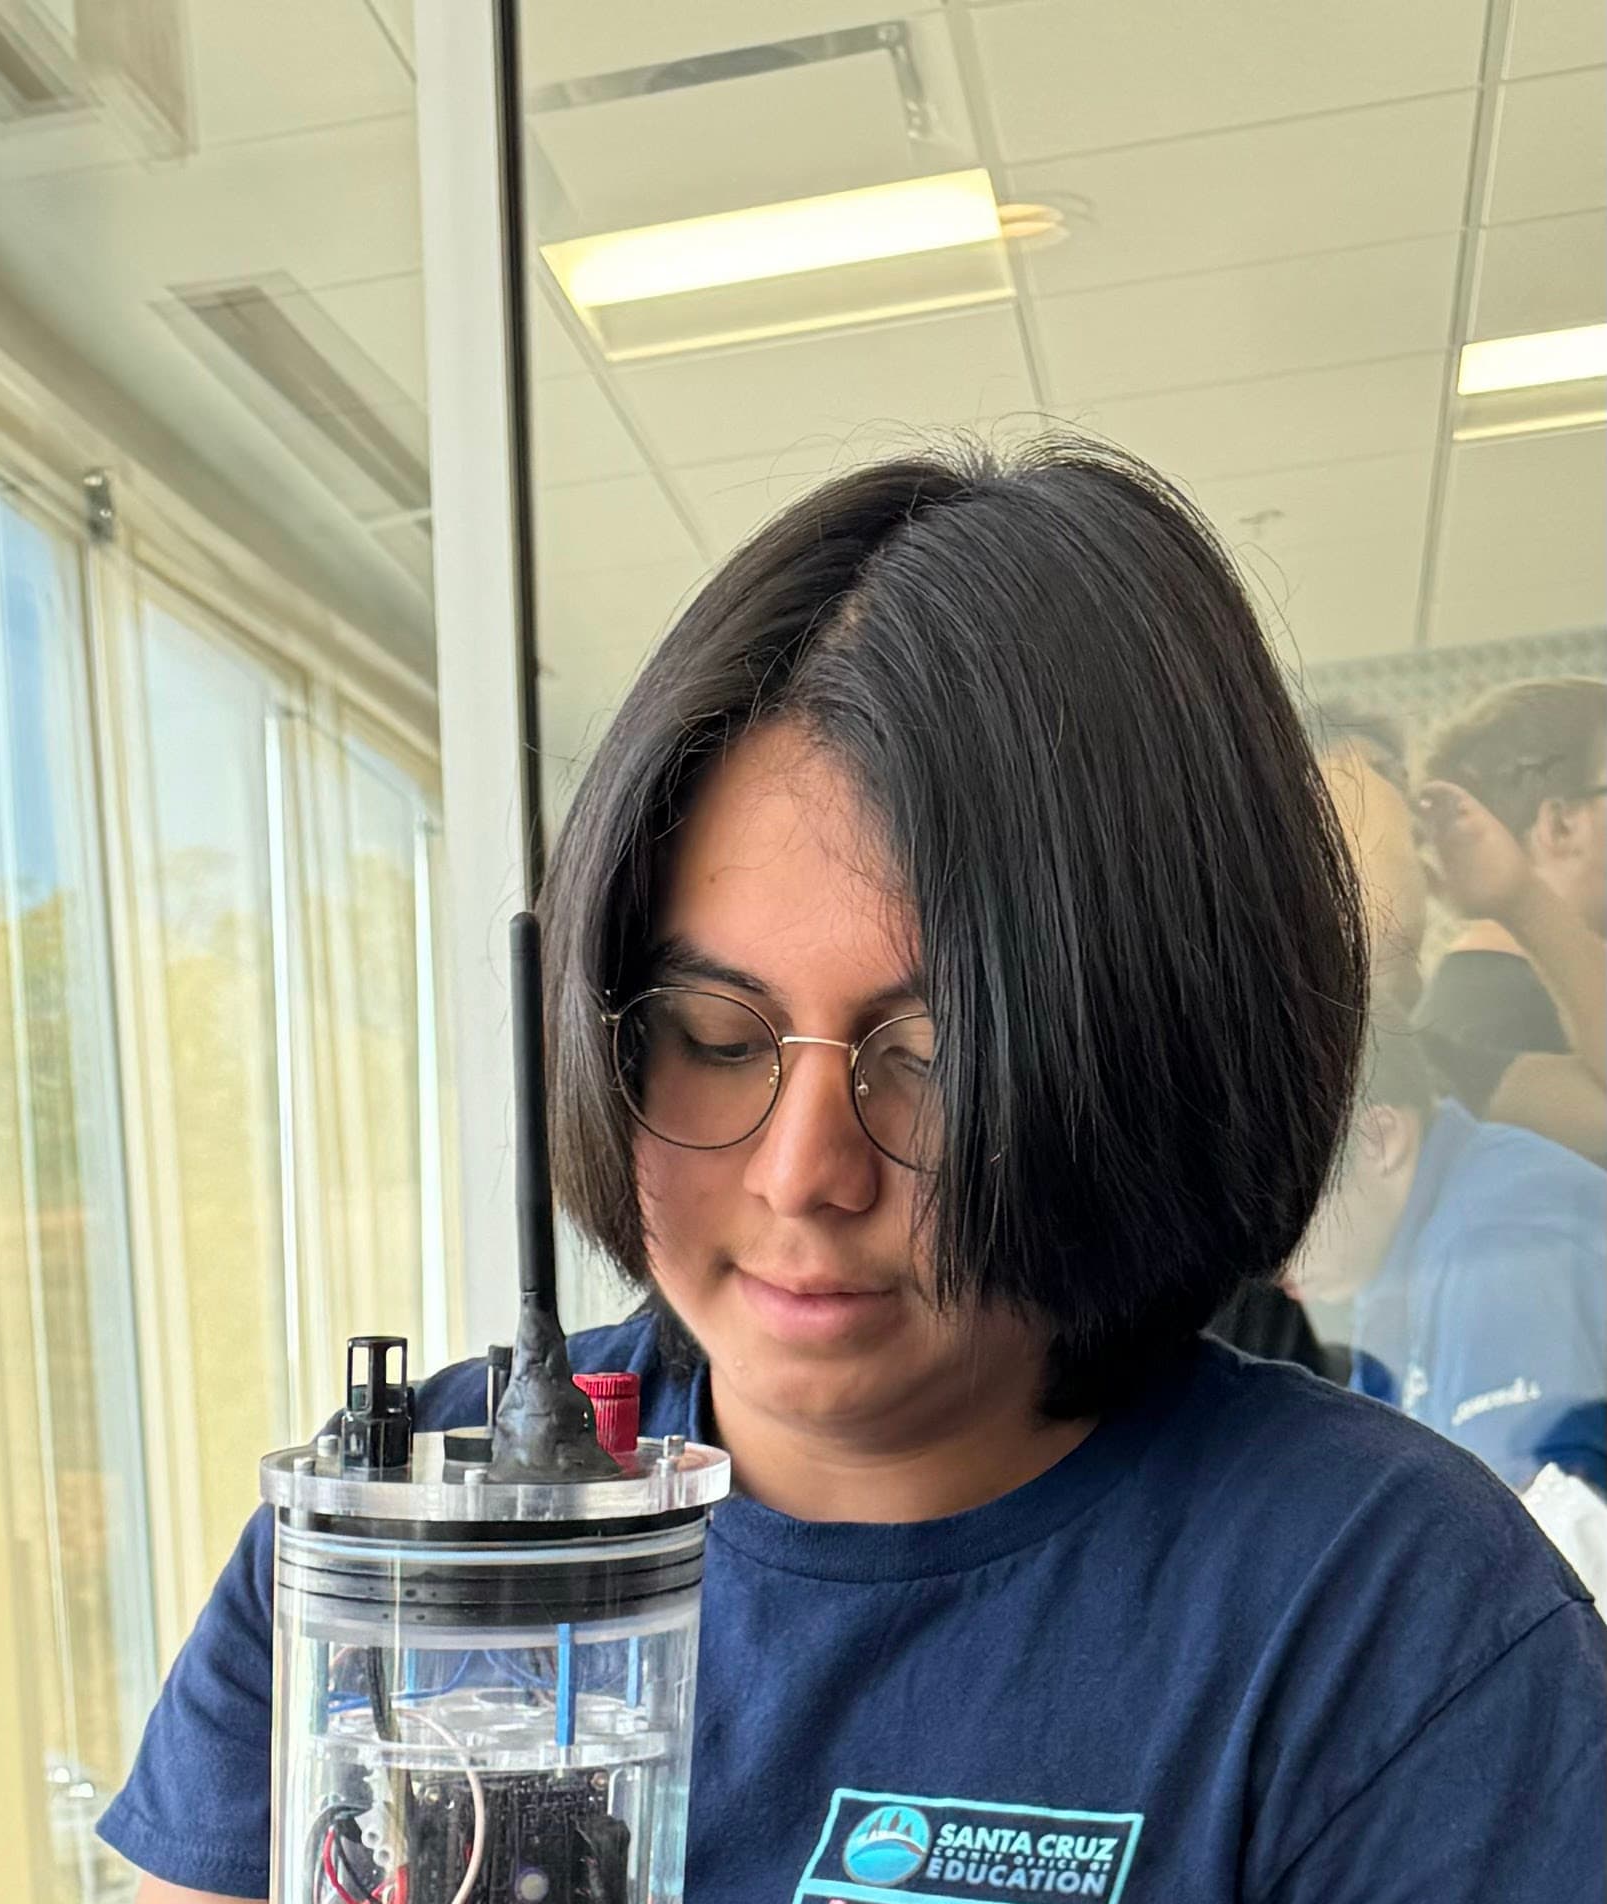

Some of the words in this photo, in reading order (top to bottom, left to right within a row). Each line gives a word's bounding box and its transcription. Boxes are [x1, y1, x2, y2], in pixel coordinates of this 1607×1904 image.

[932, 1846, 1003, 1864] COUNTY
[1013, 1855, 1078, 1870] OFFICE
[1089, 1861, 1112, 1873] OF
[936, 1823, 1032, 1856] SANTA
[1037, 1834, 1119, 1862] CRUZ
[925, 1858, 1108, 1896] EDUCATION
